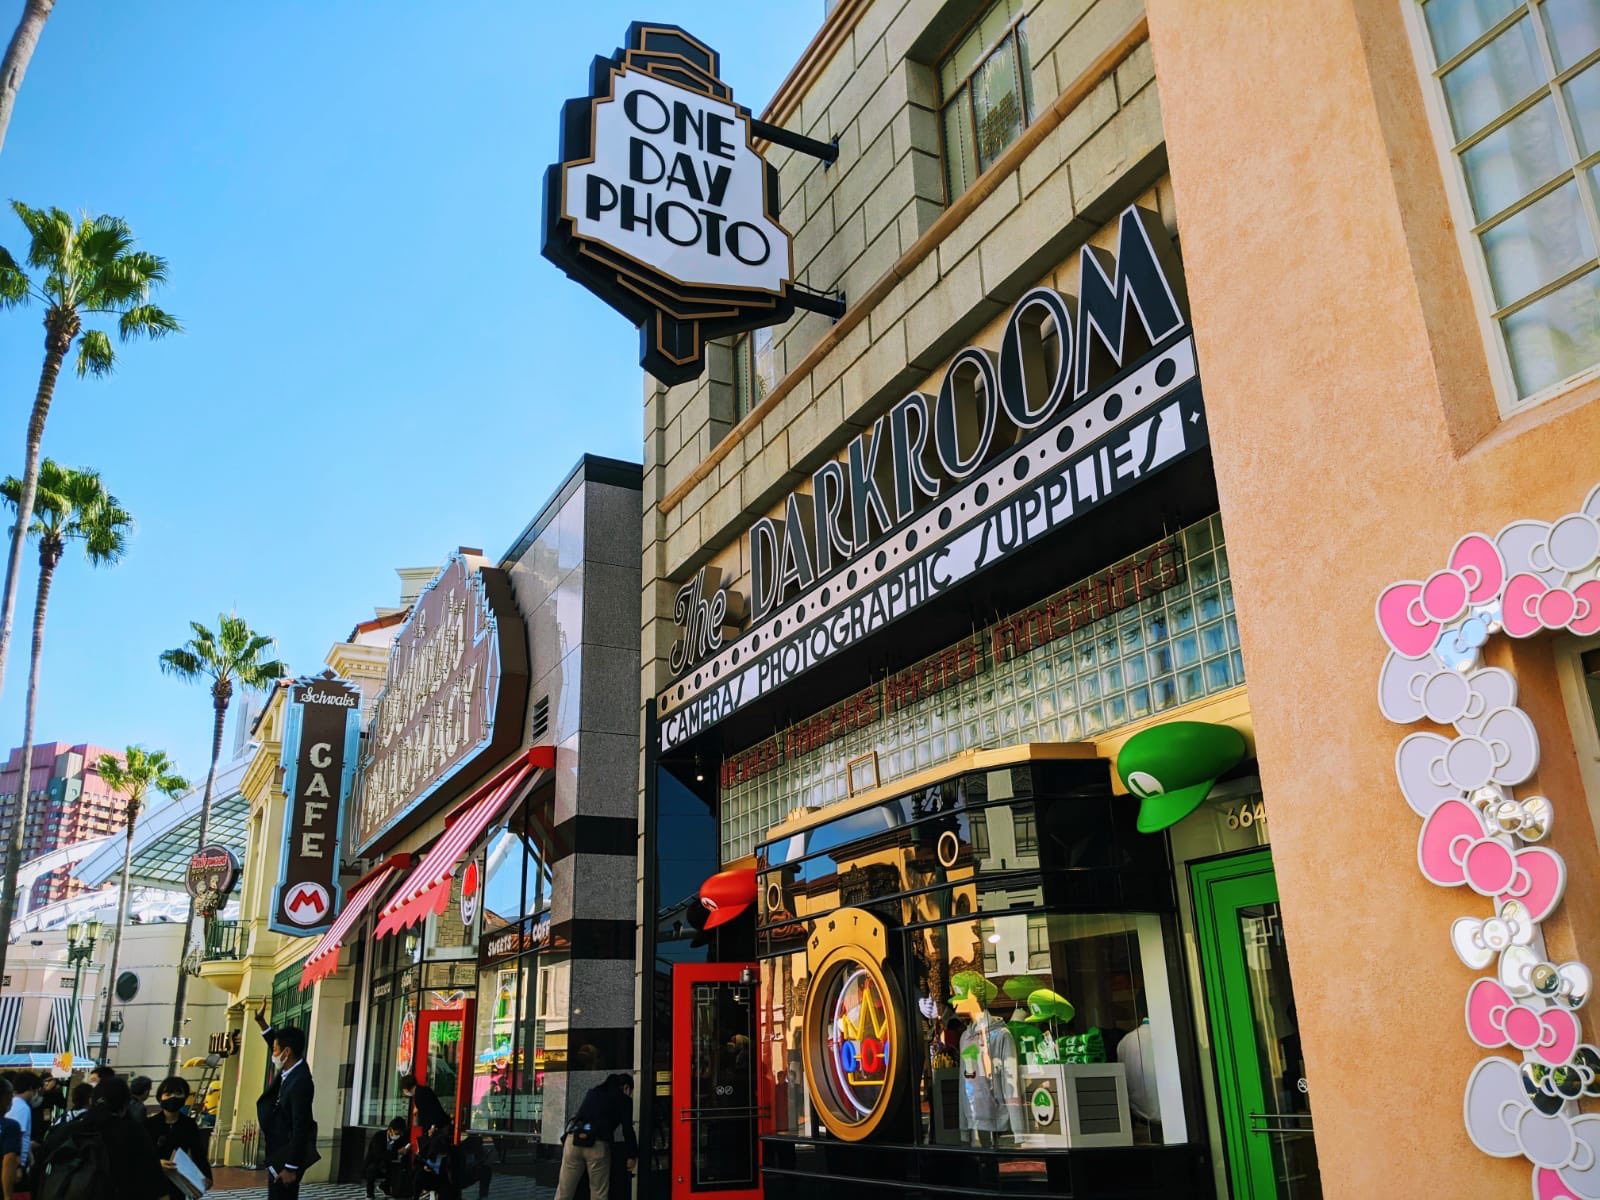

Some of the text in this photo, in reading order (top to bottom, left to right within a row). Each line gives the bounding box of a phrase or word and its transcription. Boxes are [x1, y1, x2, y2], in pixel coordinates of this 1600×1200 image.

[624, 89, 735, 161] ONE
[629, 136, 732, 207] DAY
[586, 174, 771, 266] PHOTO
[669, 204, 1185, 676] The DARKROOM
[666, 413, 1164, 747] CAMERAS PHOTOGRAPHIC SUPPLIES
[884, 641, 977, 715] PHOTO
[994, 542, 1177, 664] FINISHING
[299, 742, 332, 858] CAFE
[1226, 801, 1266, 830] 664
[488, 934, 512, 957] SWEETS
